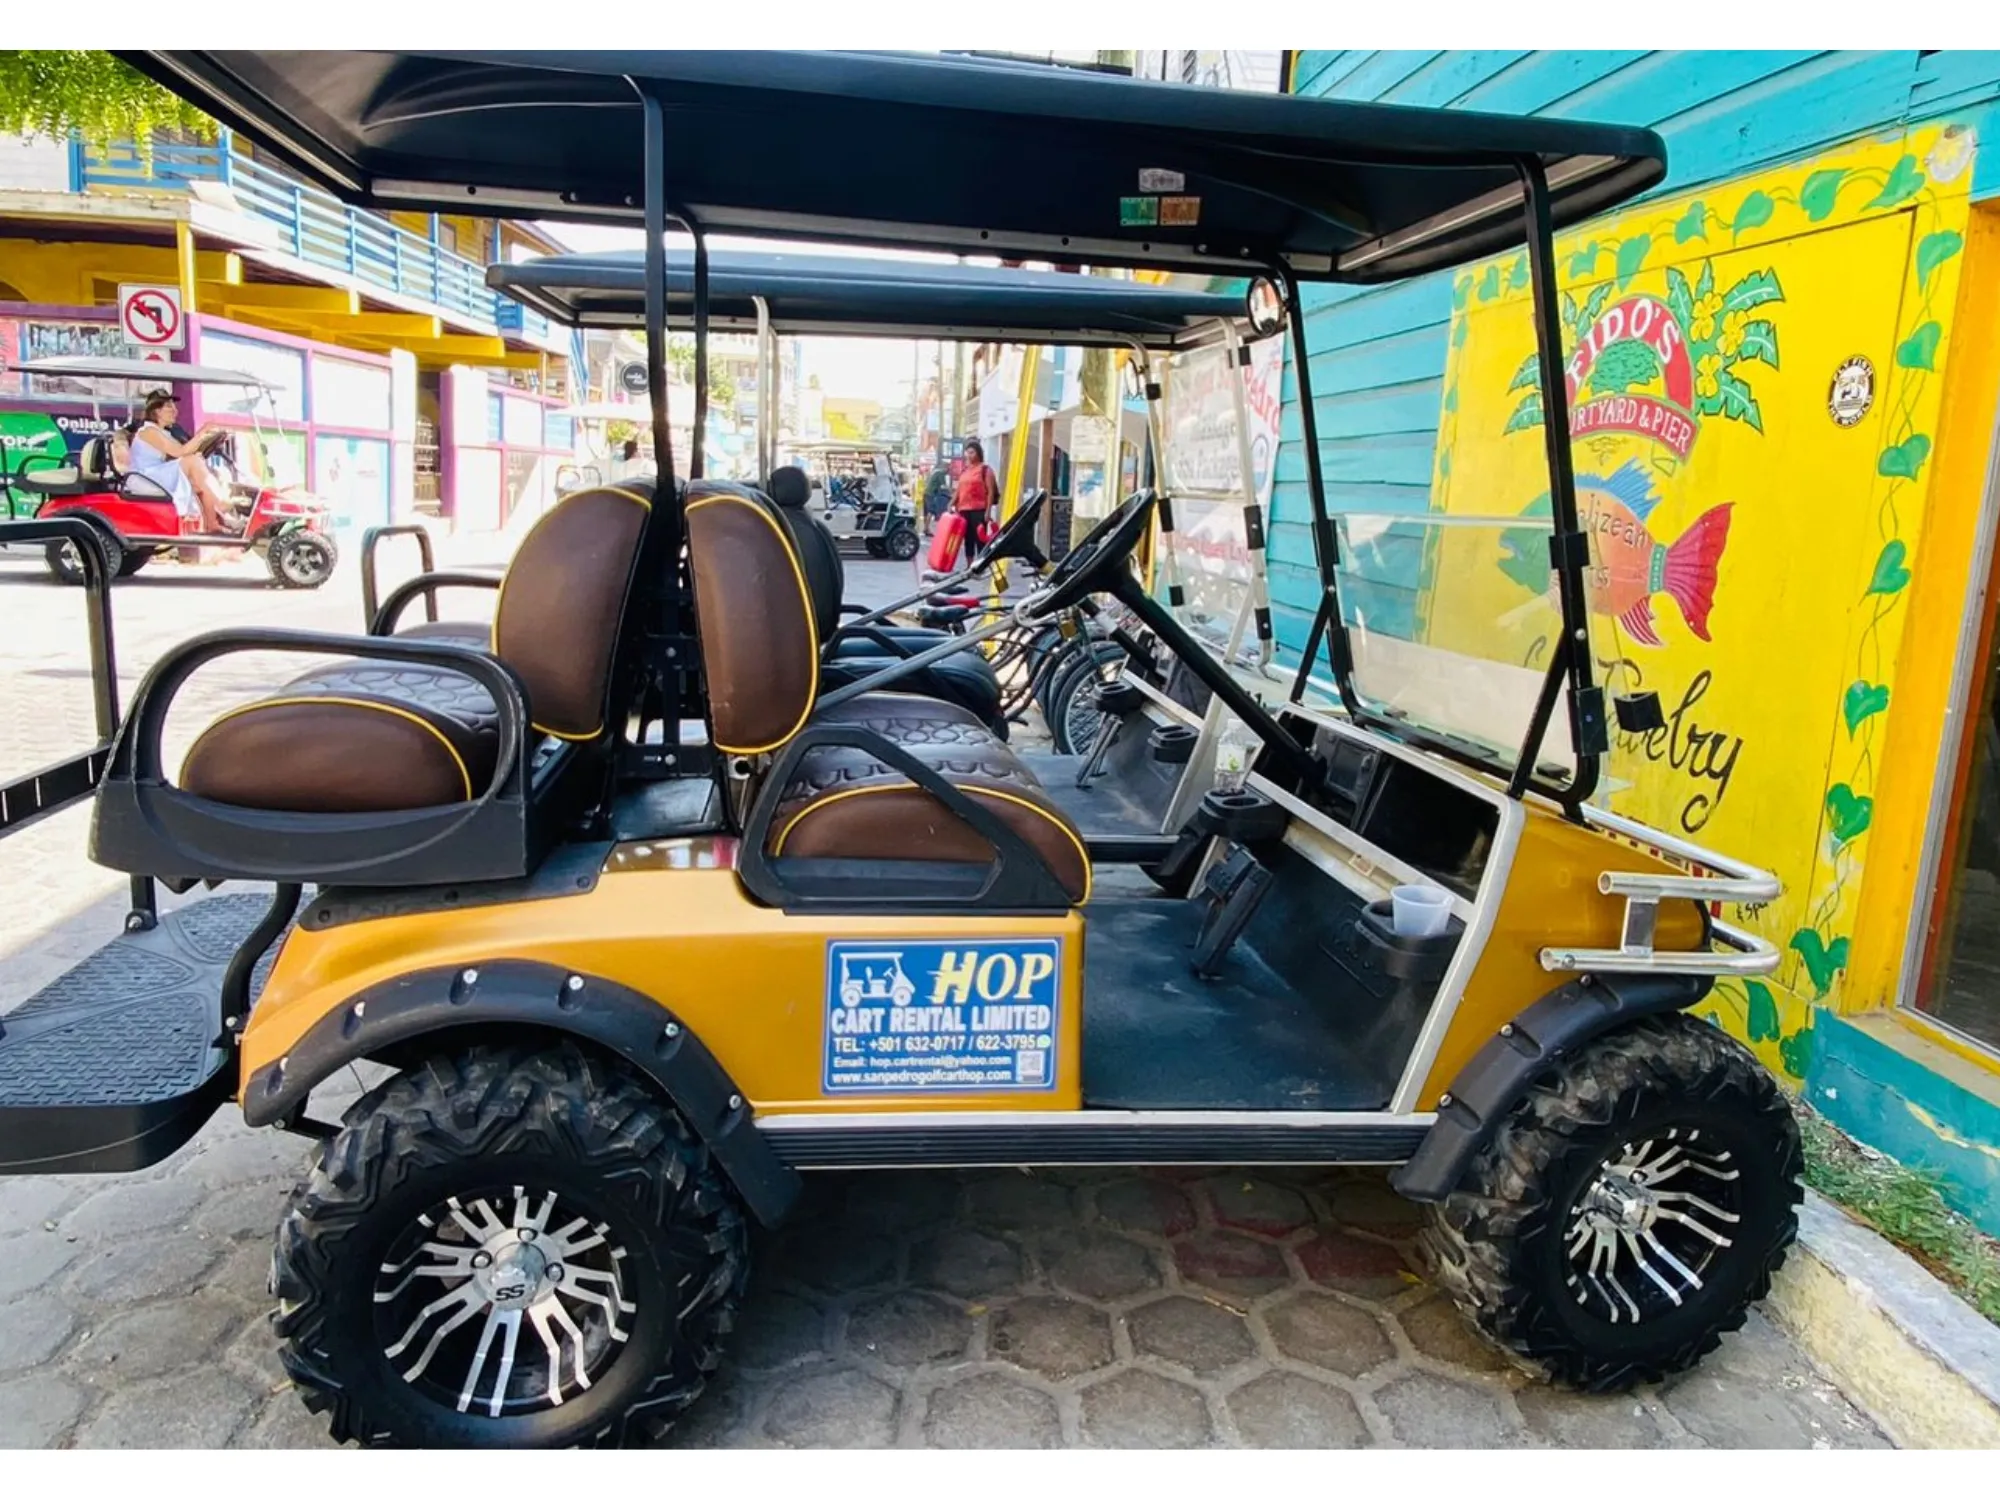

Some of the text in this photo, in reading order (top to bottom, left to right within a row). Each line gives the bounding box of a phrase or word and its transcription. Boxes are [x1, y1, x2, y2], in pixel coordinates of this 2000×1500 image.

[1565, 297, 1680, 385] FIDO'S
[1651, 409, 1693, 453] PIER
[1578, 493, 1648, 549] elizean
[926, 951, 1054, 1005] HOP
[831, 1004, 1051, 1034] CART RENTAL LIMITED
[833, 1056, 867, 1068] Email:
[834, 1037, 865, 1053] TEL:
[870, 1036, 901, 1052] +501
[905, 1035, 965, 1052] 632-0717
[976, 1035, 1036, 1051] 622-3795
